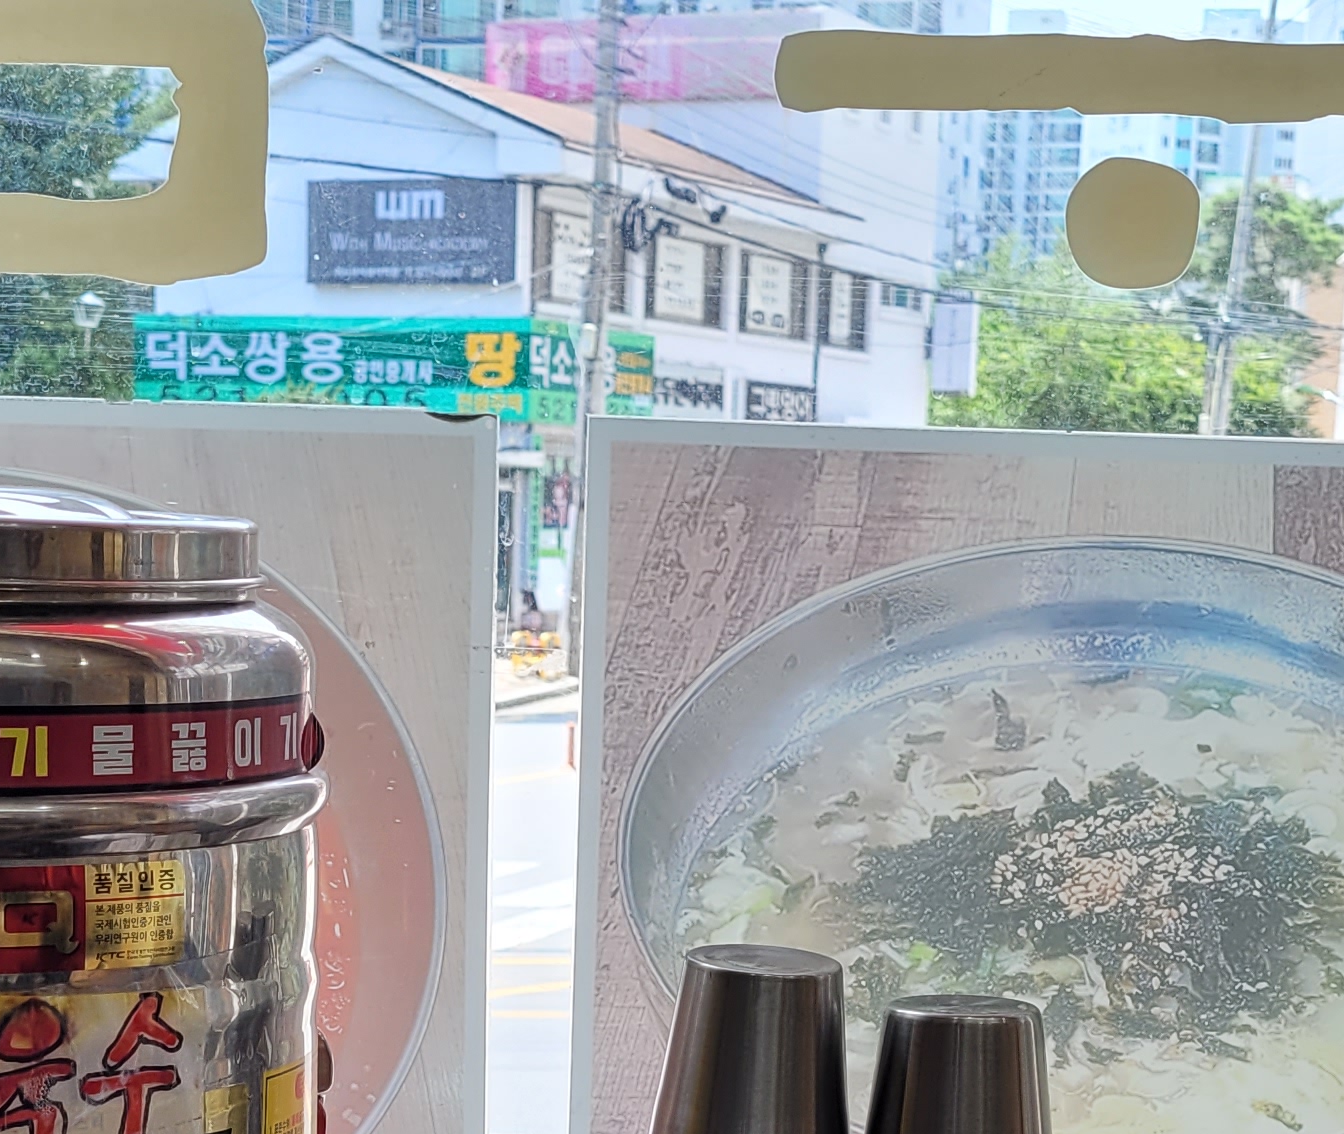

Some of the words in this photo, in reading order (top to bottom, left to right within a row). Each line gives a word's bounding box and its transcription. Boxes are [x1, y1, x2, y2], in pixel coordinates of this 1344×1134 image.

[145, 331, 345, 383] 덕소쌍용
[465, 332, 522, 388] 땅
[93, 868, 176, 895] 품질인증
